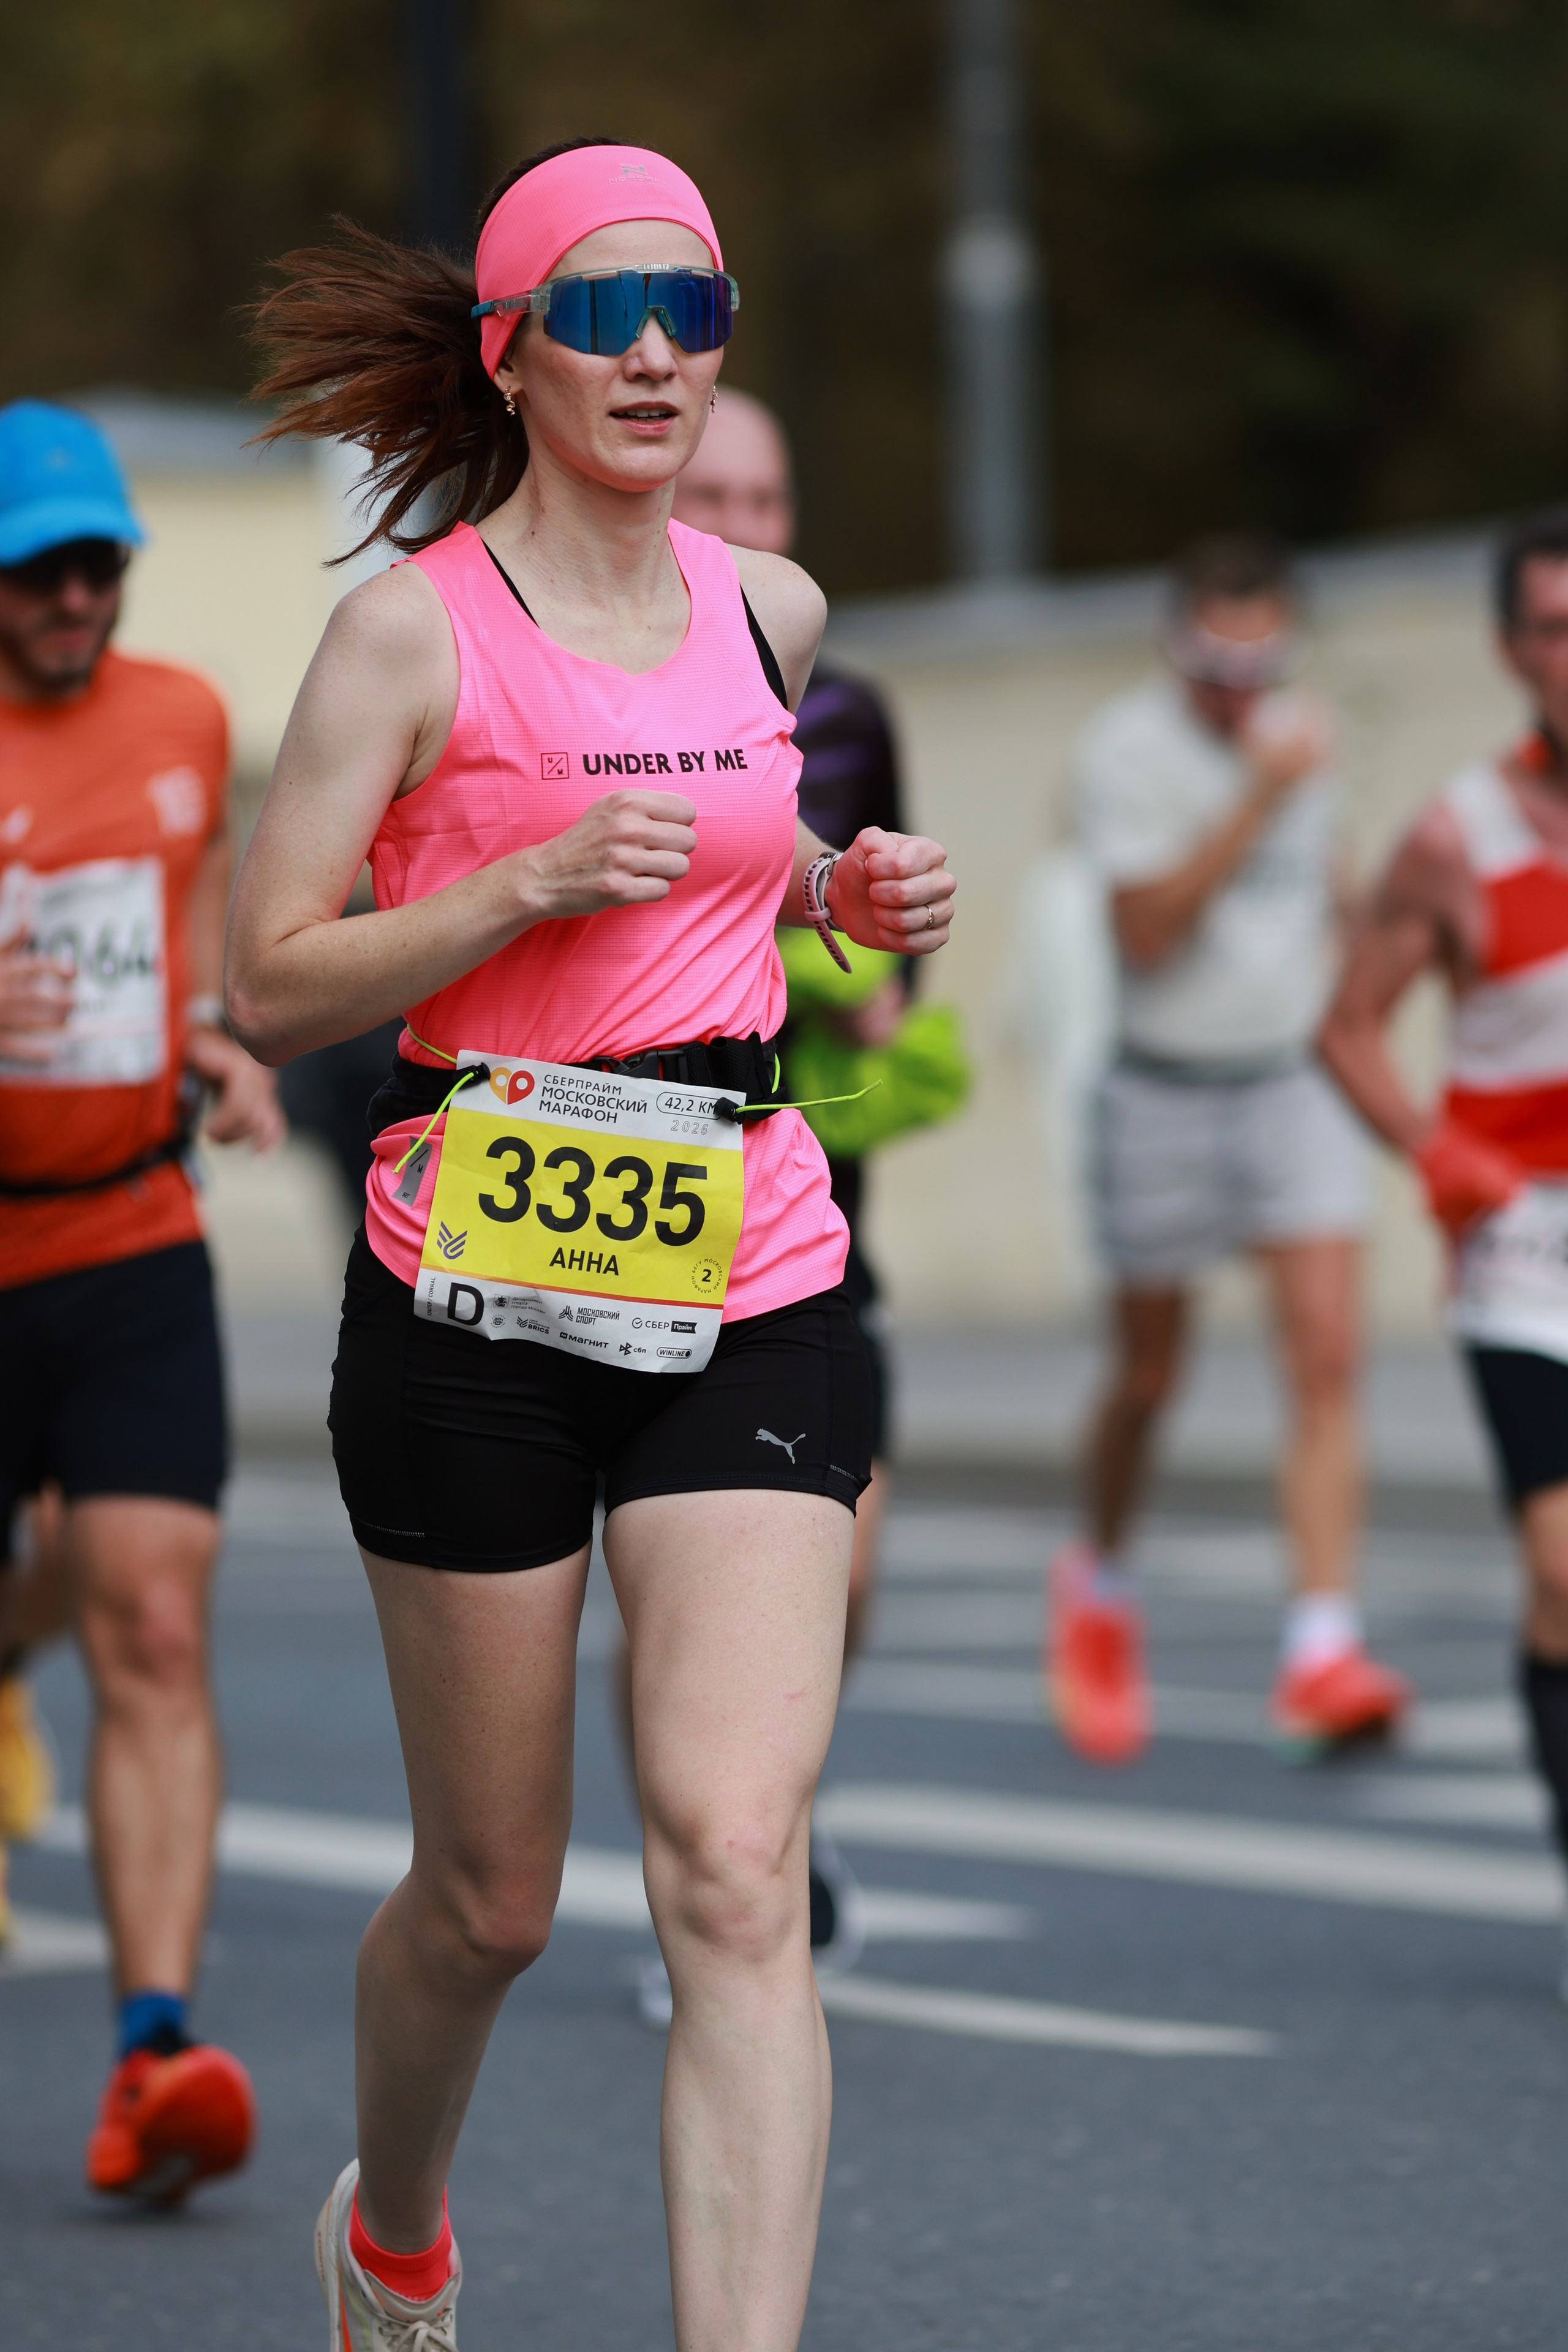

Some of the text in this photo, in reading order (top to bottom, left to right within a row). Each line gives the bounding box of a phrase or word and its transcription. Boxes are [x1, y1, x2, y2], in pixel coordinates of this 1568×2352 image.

[582, 749, 748, 775] UNDER BY ME
[544, 1074, 622, 1095] СБЕРПРАЙМ
[541, 1086, 648, 1114] МОСКОВСКИЙ
[665, 1097, 694, 1112] 42,2
[539, 1100, 618, 1123] МАРАФОН
[670, 1120, 709, 1136] 2026
[478, 1136, 708, 1246] 3335
[549, 1247, 620, 1276] АННА
[691, 1258, 723, 1294] БЕГУ МОСКОВСКИЙ МАРАФОН
[701, 1268, 712, 1283] 2
[447, 1282, 484, 1326] D
[576, 1316, 597, 1325] СПОРТ
[577, 1307, 620, 1321] МОСКОВСКИЙ
[527, 1324, 550, 1335] BRICS
[645, 1321, 693, 1332] СБЕР Прайм
[659, 1349, 685, 1357] WINLINE
